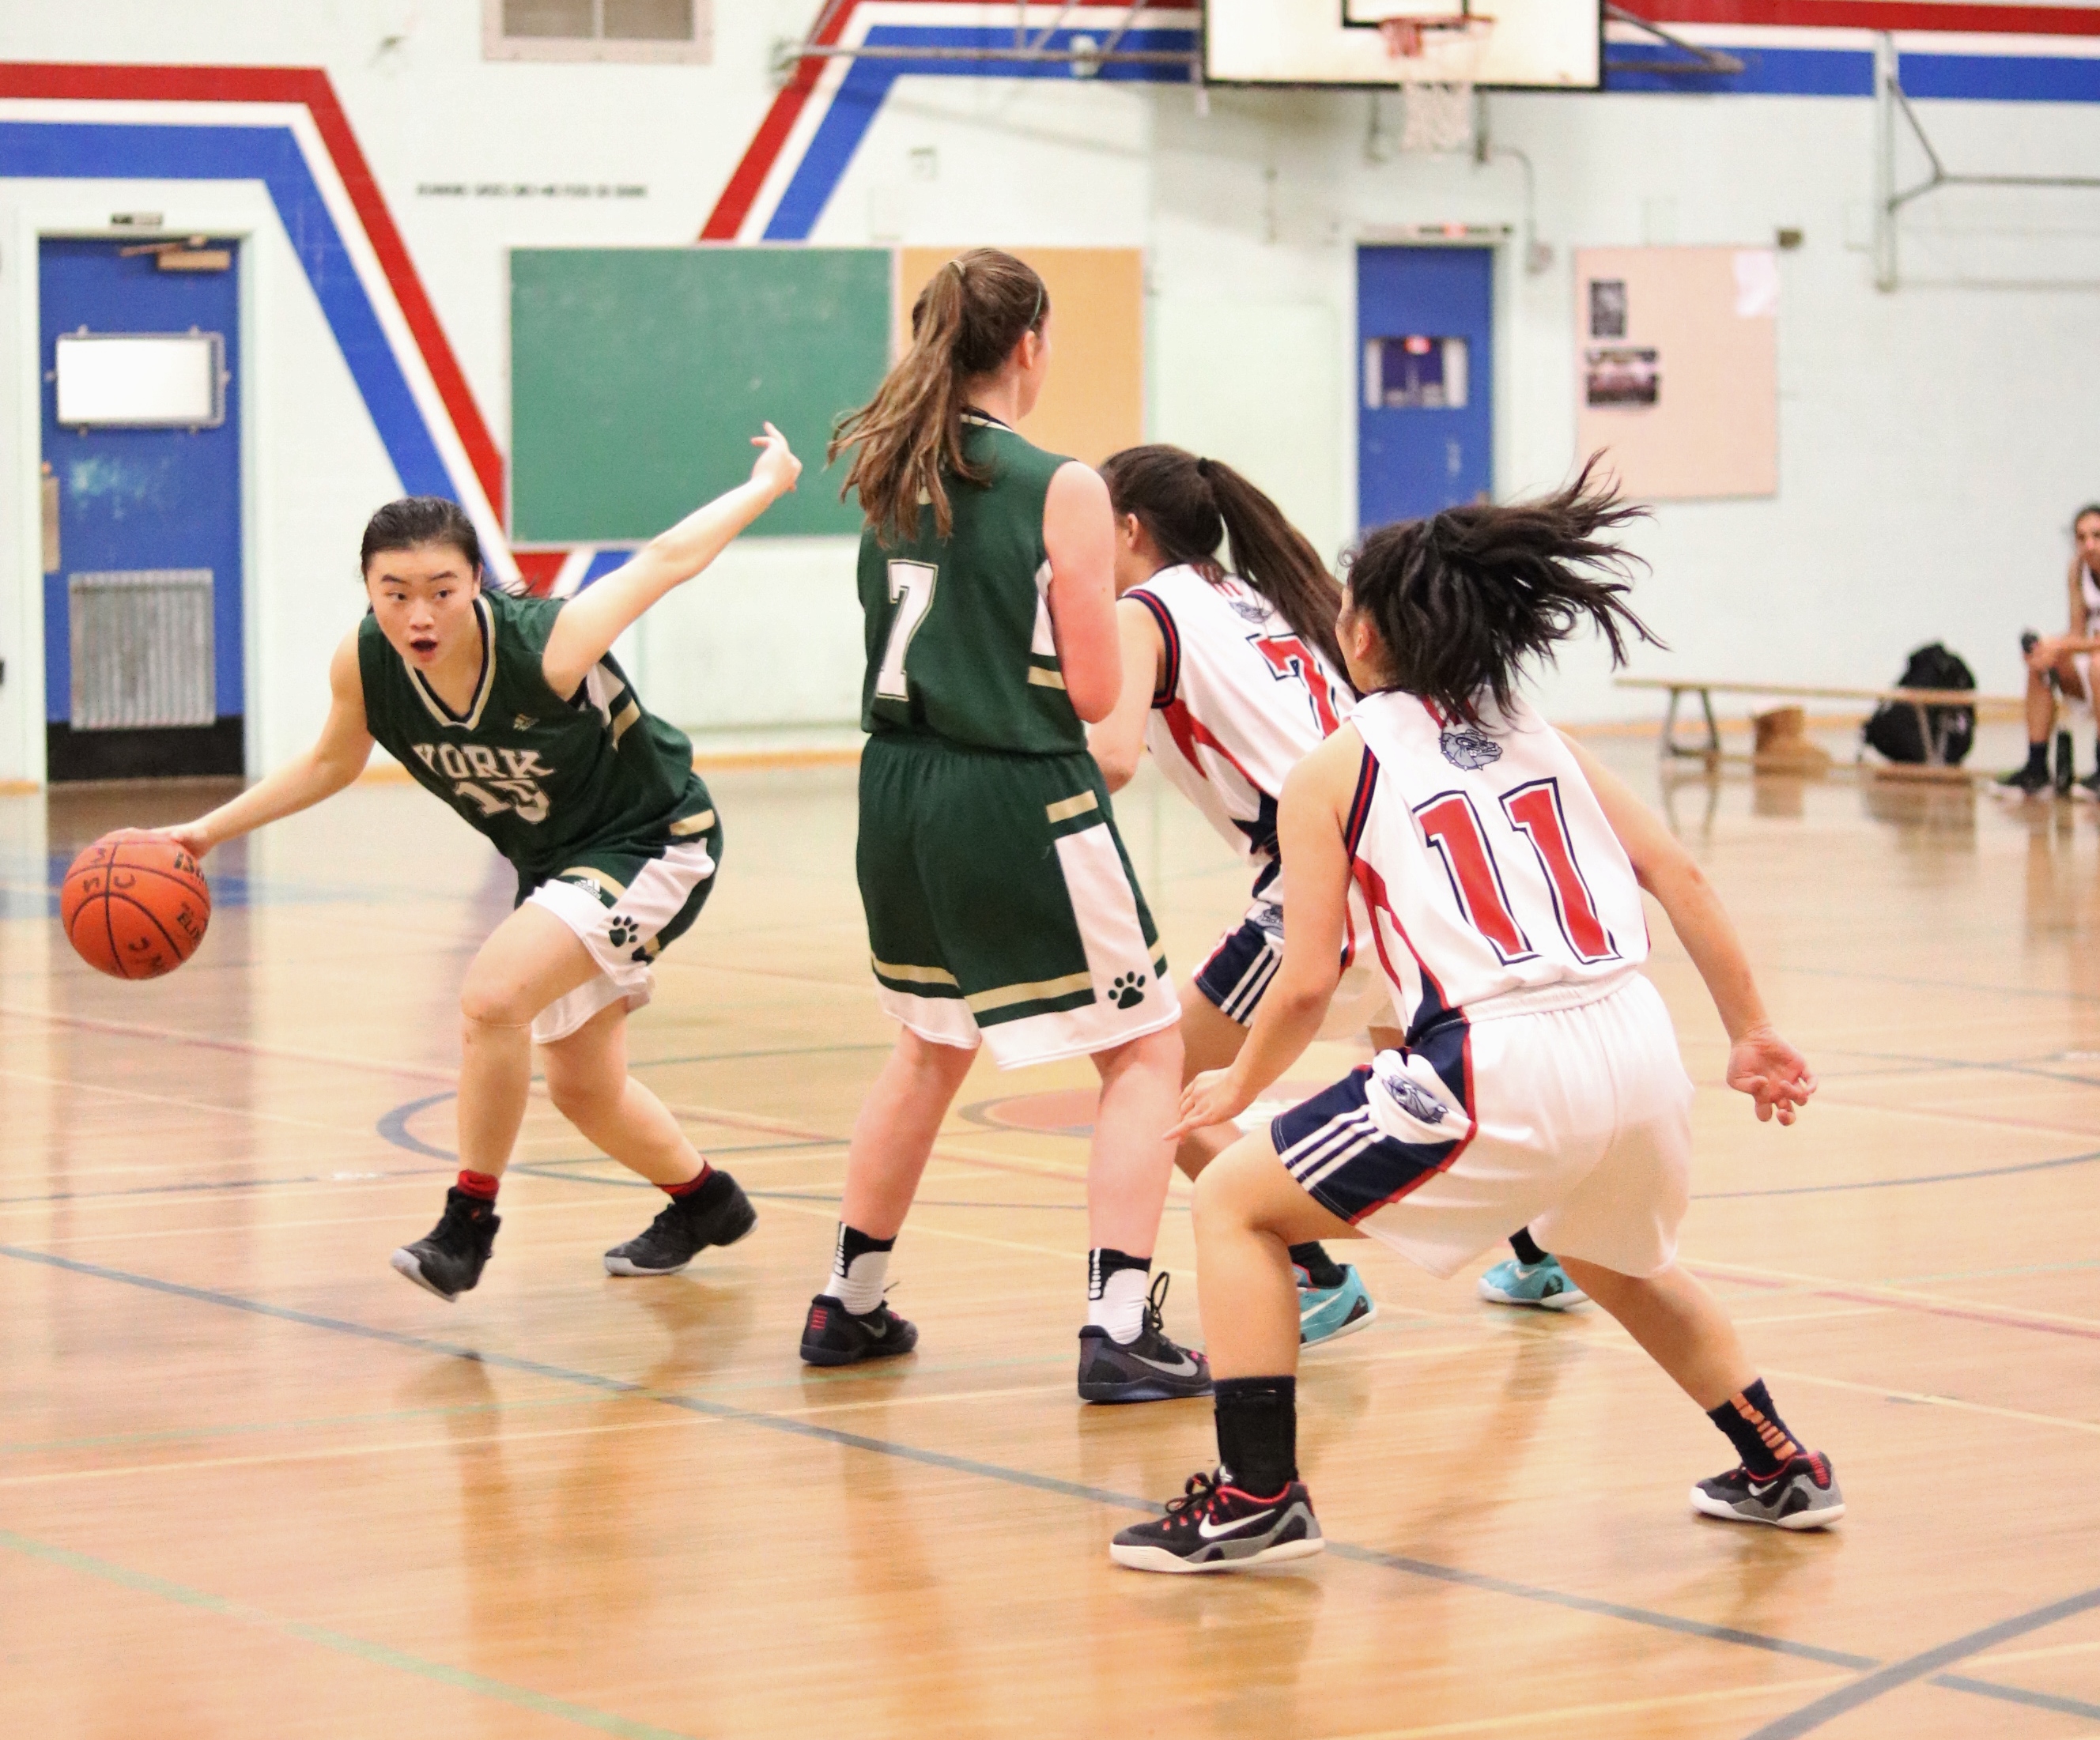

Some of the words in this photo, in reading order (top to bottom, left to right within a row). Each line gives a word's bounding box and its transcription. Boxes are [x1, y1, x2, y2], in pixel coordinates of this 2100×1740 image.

[876, 559, 939, 701] 7
[1246, 632, 1341, 740] 7
[412, 742, 557, 779] YORK
[1412, 777, 1623, 966] 11
